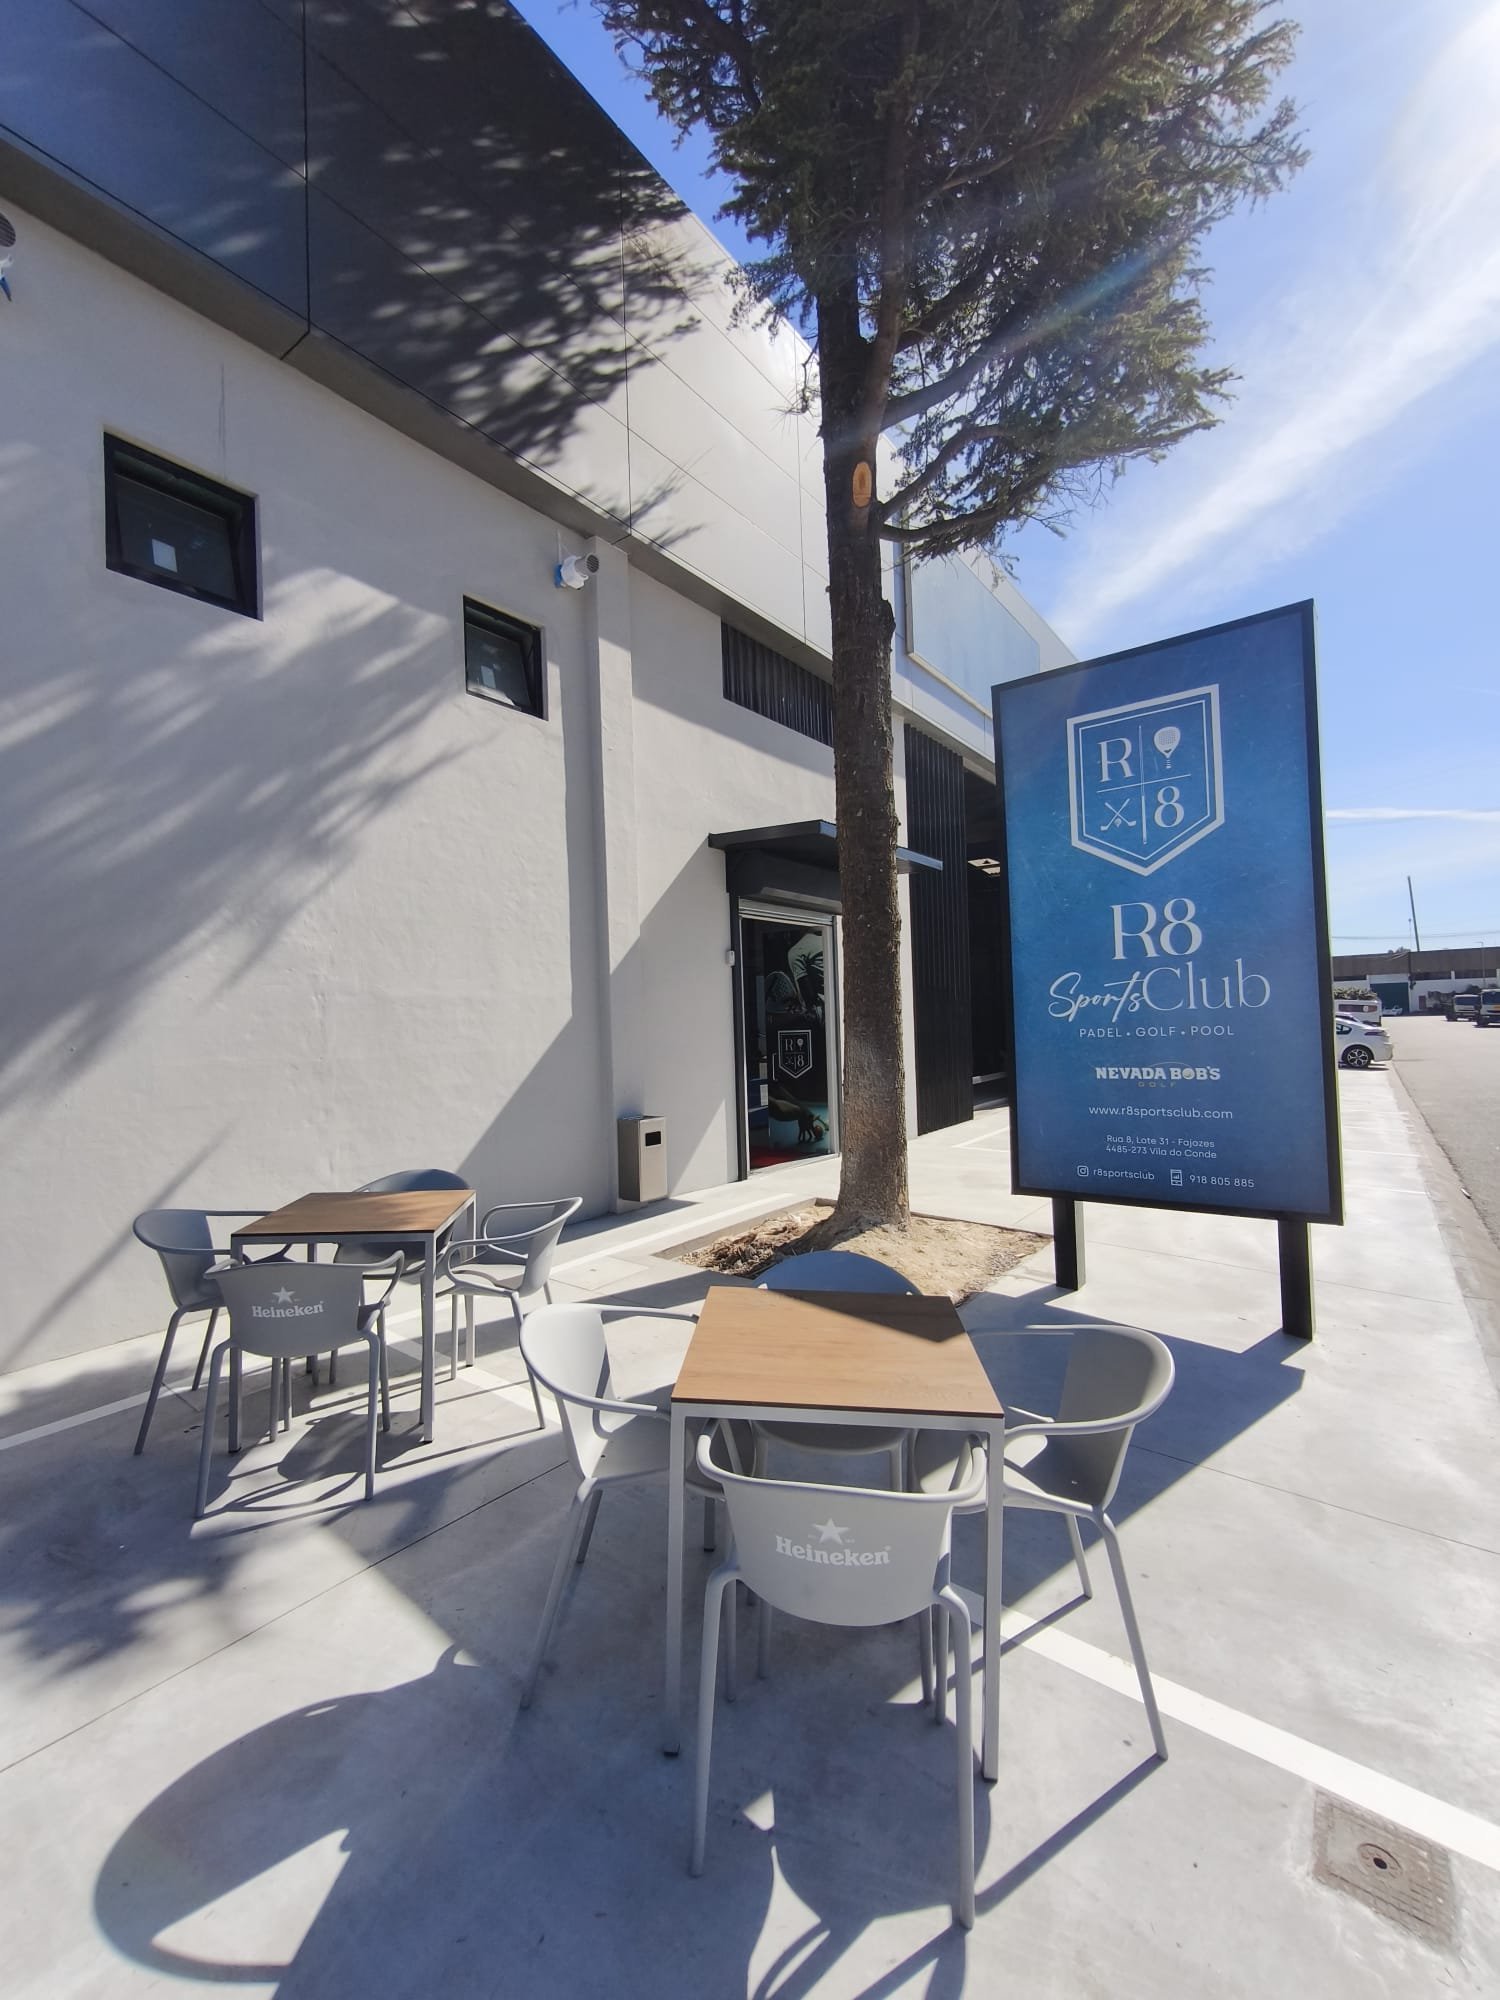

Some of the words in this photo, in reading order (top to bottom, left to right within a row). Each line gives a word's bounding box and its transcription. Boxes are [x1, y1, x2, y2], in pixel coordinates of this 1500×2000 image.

[1097, 737, 1135, 782] R
[1154, 785, 1185, 828] 8
[1110, 897, 1203, 960] R8
[1079, 1027, 1122, 1038] PADEL
[1135, 1026, 1177, 1037] GOLF
[1190, 1025, 1235, 1036] POOL
[1095, 1066, 1167, 1080] NEVADA
[1088, 1105, 1233, 1120] www.r8sportsclub.com
[1106, 1134, 1124, 1143] Rua
[1136, 1136, 1157, 1145] Lote
[1159, 1137, 1169, 1146] 31
[1177, 1138, 1216, 1149] Fajozes
[1106, 1144, 1147, 1155] 4485-273
[1149, 1147, 1167, 1156] Vila
[1169, 1148, 1182, 1157] do
[1184, 1149, 1217, 1159] Conde
[1093, 1167, 1155, 1181] r8sportsclub
[1189, 1174, 1208, 1185] 918
[1210, 1176, 1231, 1186] 805
[1233, 1178, 1255, 1188] 885
[251, 1302, 325, 1318] Heineken
[775, 1535, 891, 1567] Heineken
